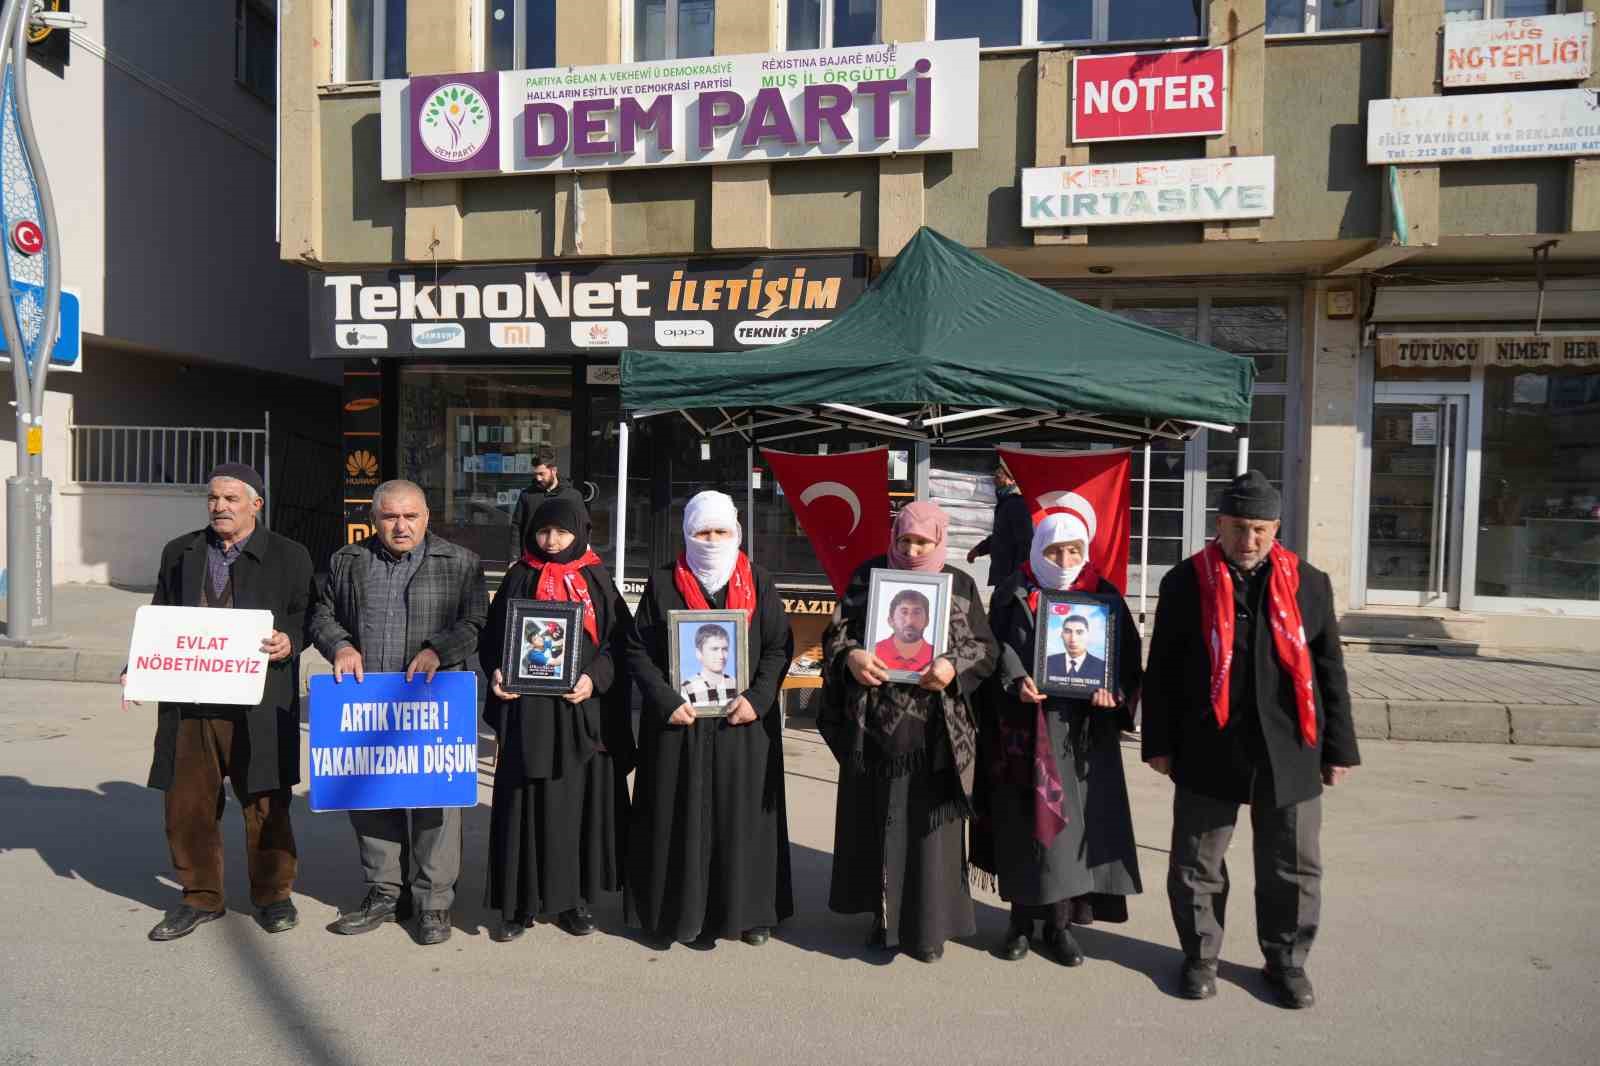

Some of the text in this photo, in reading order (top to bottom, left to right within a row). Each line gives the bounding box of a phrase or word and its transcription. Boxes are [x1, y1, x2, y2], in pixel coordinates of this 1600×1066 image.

[527, 75, 732, 101] HALKLARIN EŞİTLİK VE DEMOKRASİ PARTİSİ
[565, 72, 598, 85] GELAN
[600, 72, 607, 82] A
[762, 64, 897, 89] MUŞ İL ÖRGÜTÜ
[1083, 74, 1216, 115] NOTER
[524, 58, 932, 158] DEM PARTİ
[1415, 130, 1489, 145] YAYINCILIK
[434, 145, 451, 158] DEM
[1417, 147, 1439, 157] 212
[1029, 183, 1267, 219] KIRTASİYE
[324, 267, 842, 321] TeknoNet İLETİŞİM
[738, 325, 789, 338] TEKNİK
[1399, 339, 1480, 360] TÜTÜNCÜ
[1497, 340, 1551, 359] NİMET
[175, 636, 229, 651] EVLAT
[136, 653, 262, 674] NÖBETİNDEYİZ
[340, 701, 449, 733] ARTIK YETER !
[311, 736, 477, 782] YAKAMIZDAN DÜŞÜN
